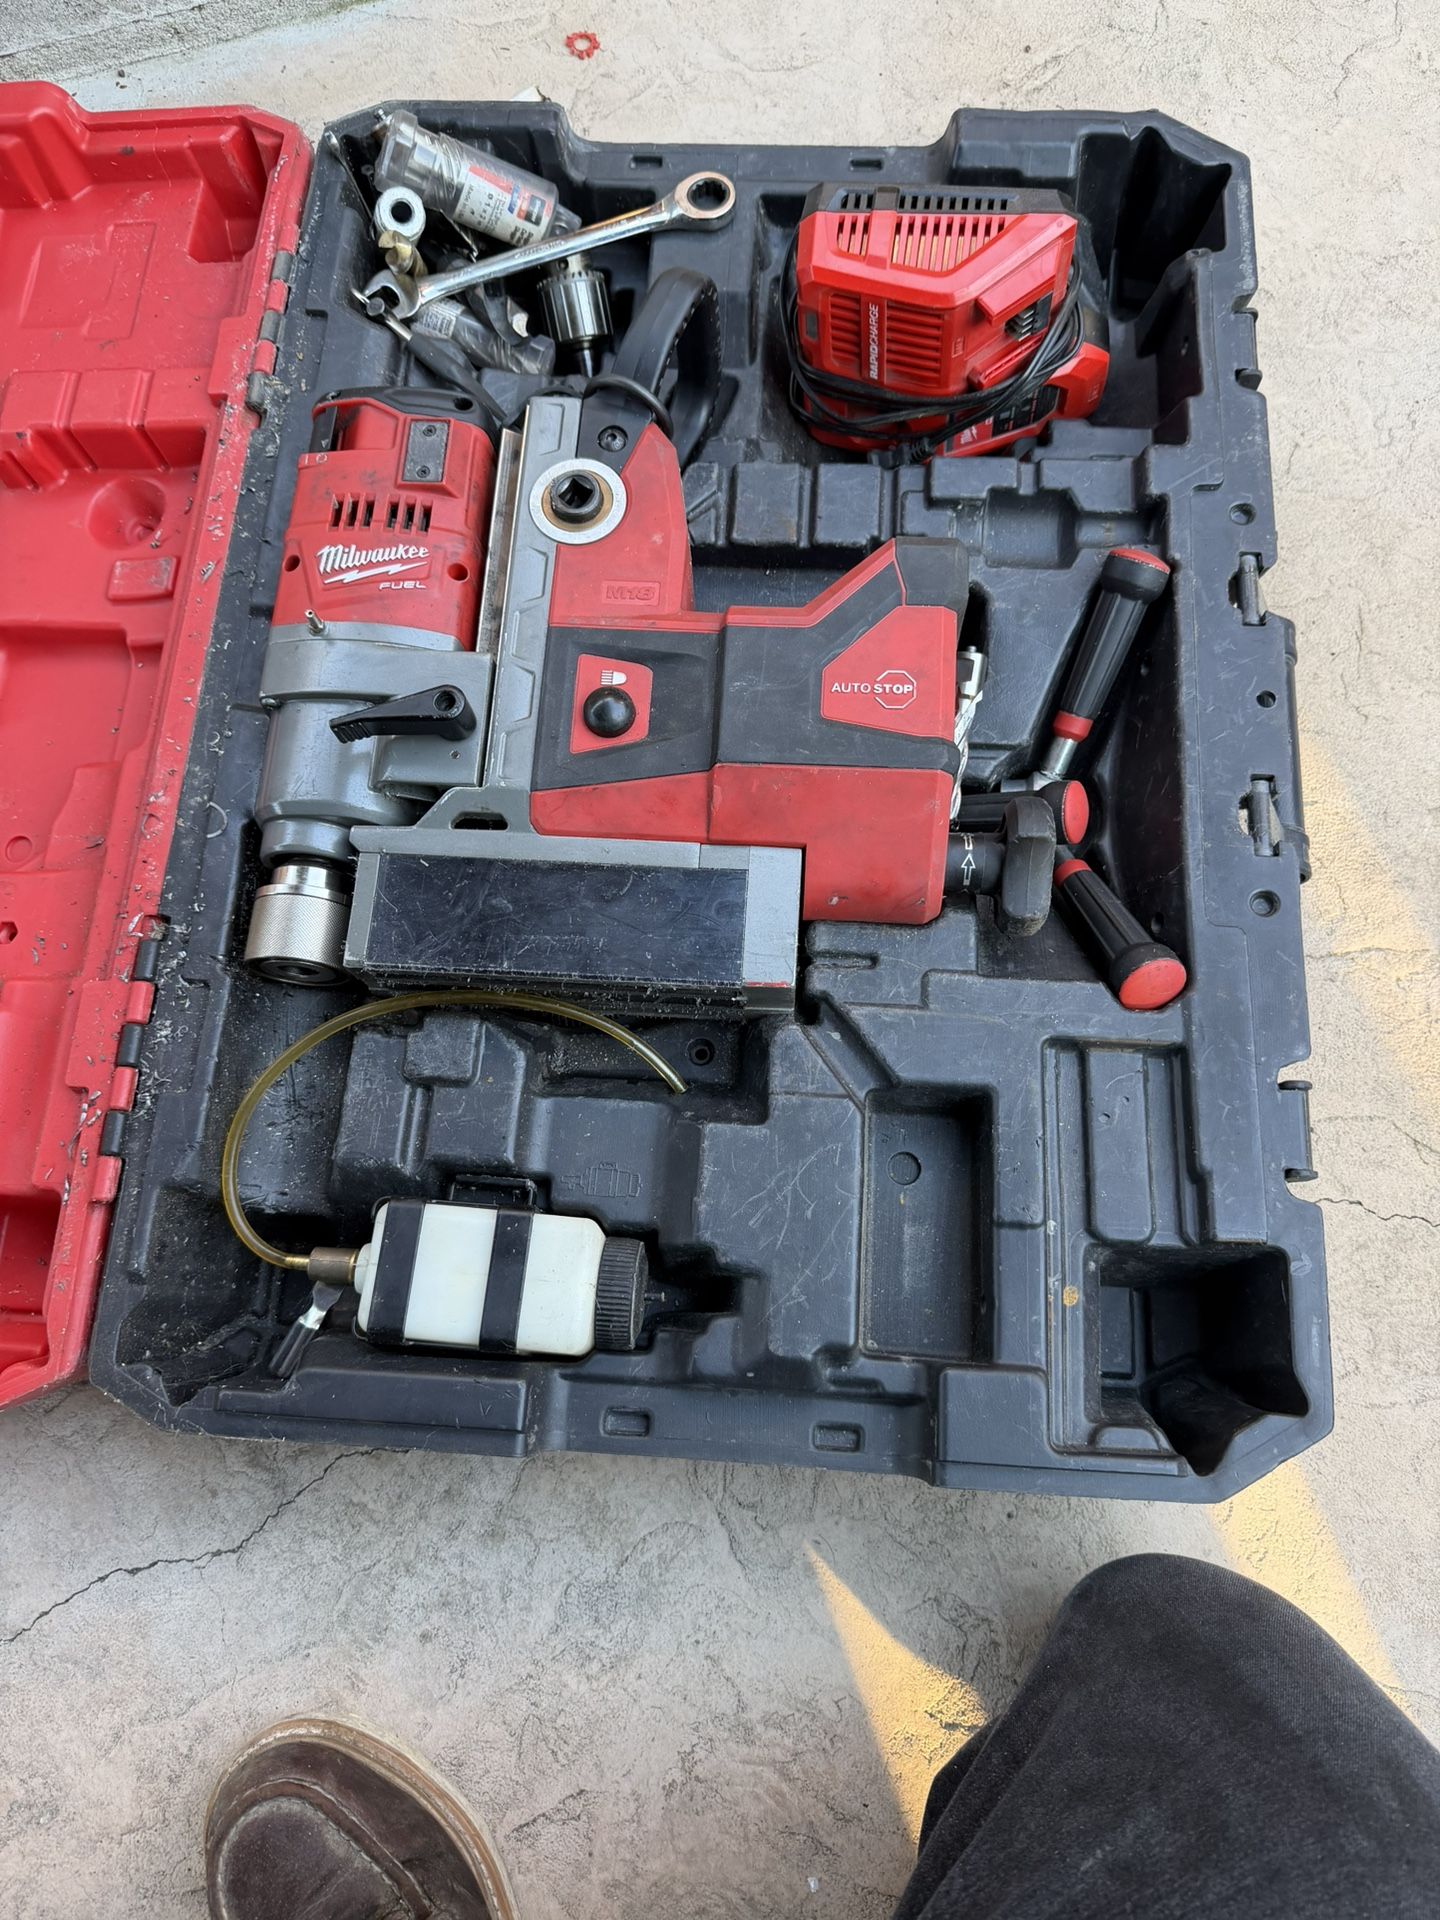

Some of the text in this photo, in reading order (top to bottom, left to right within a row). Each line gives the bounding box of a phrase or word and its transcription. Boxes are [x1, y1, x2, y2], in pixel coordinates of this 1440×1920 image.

[869, 302, 878, 380] RAPIDCHARGE
[316, 544, 430, 575] Milwaukee
[379, 581, 427, 590] FUEL
[606, 585, 655, 601] M18
[831, 682, 913, 695] AUTO STOP
